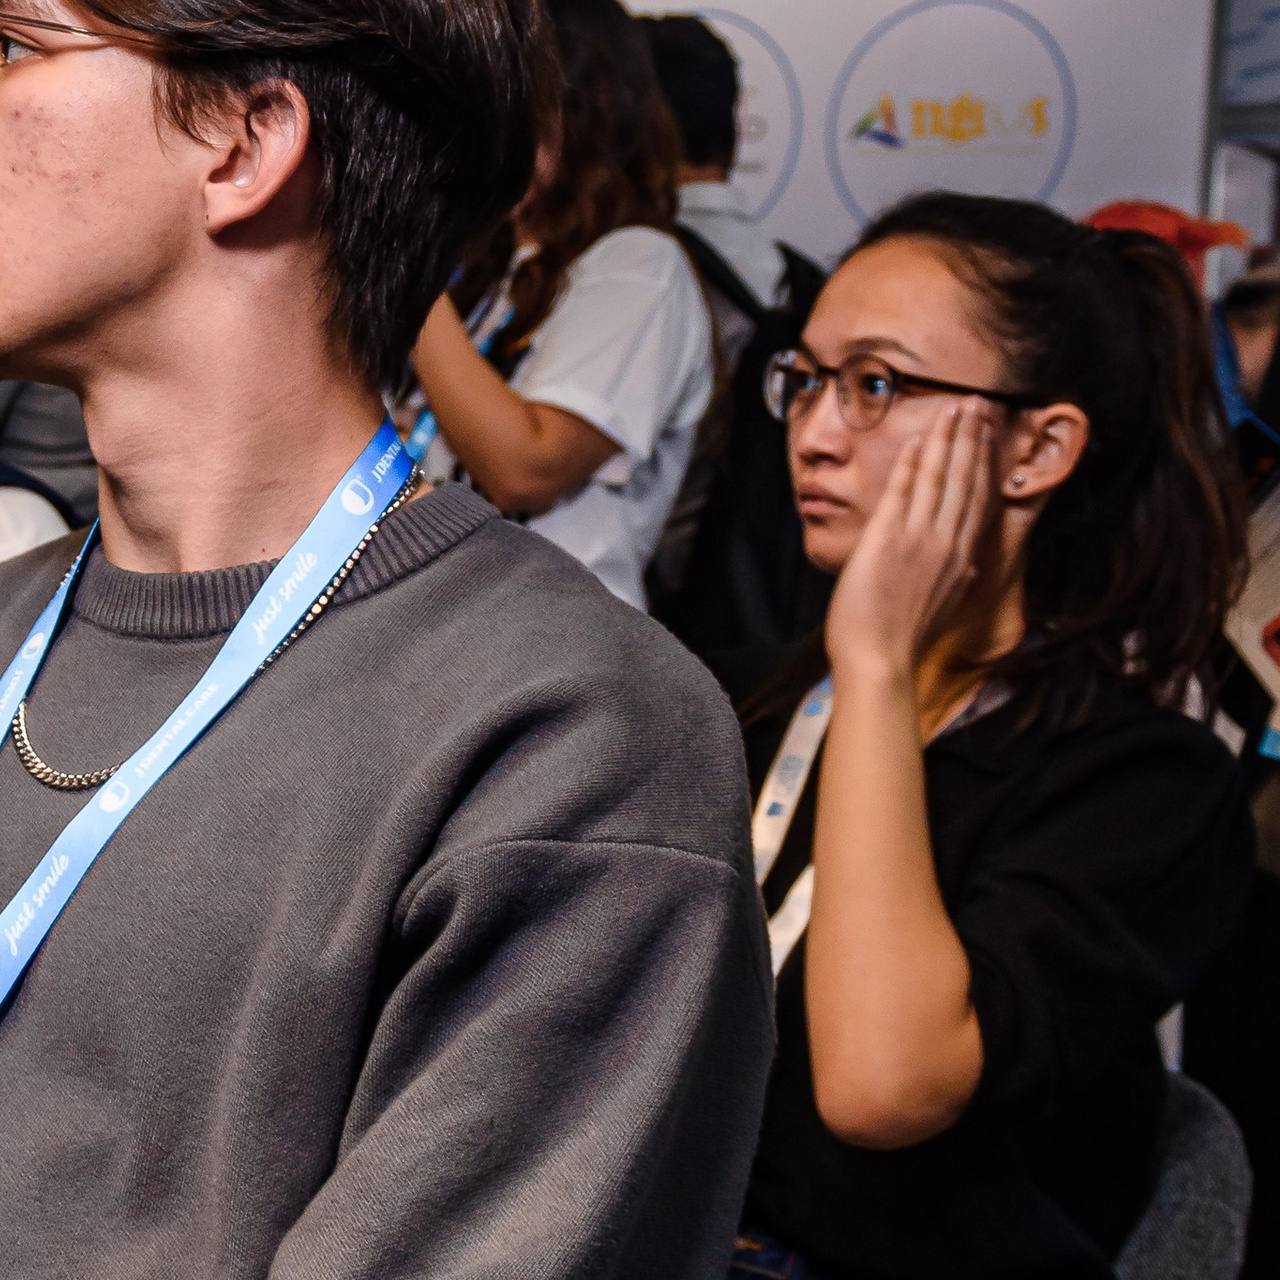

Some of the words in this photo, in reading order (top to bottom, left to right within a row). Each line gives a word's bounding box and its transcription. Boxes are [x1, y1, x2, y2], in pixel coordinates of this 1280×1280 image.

[252, 594, 282, 645] just
[278, 551, 318, 601] smile
[3, 901, 36, 957] just
[32, 853, 69, 908] smile
